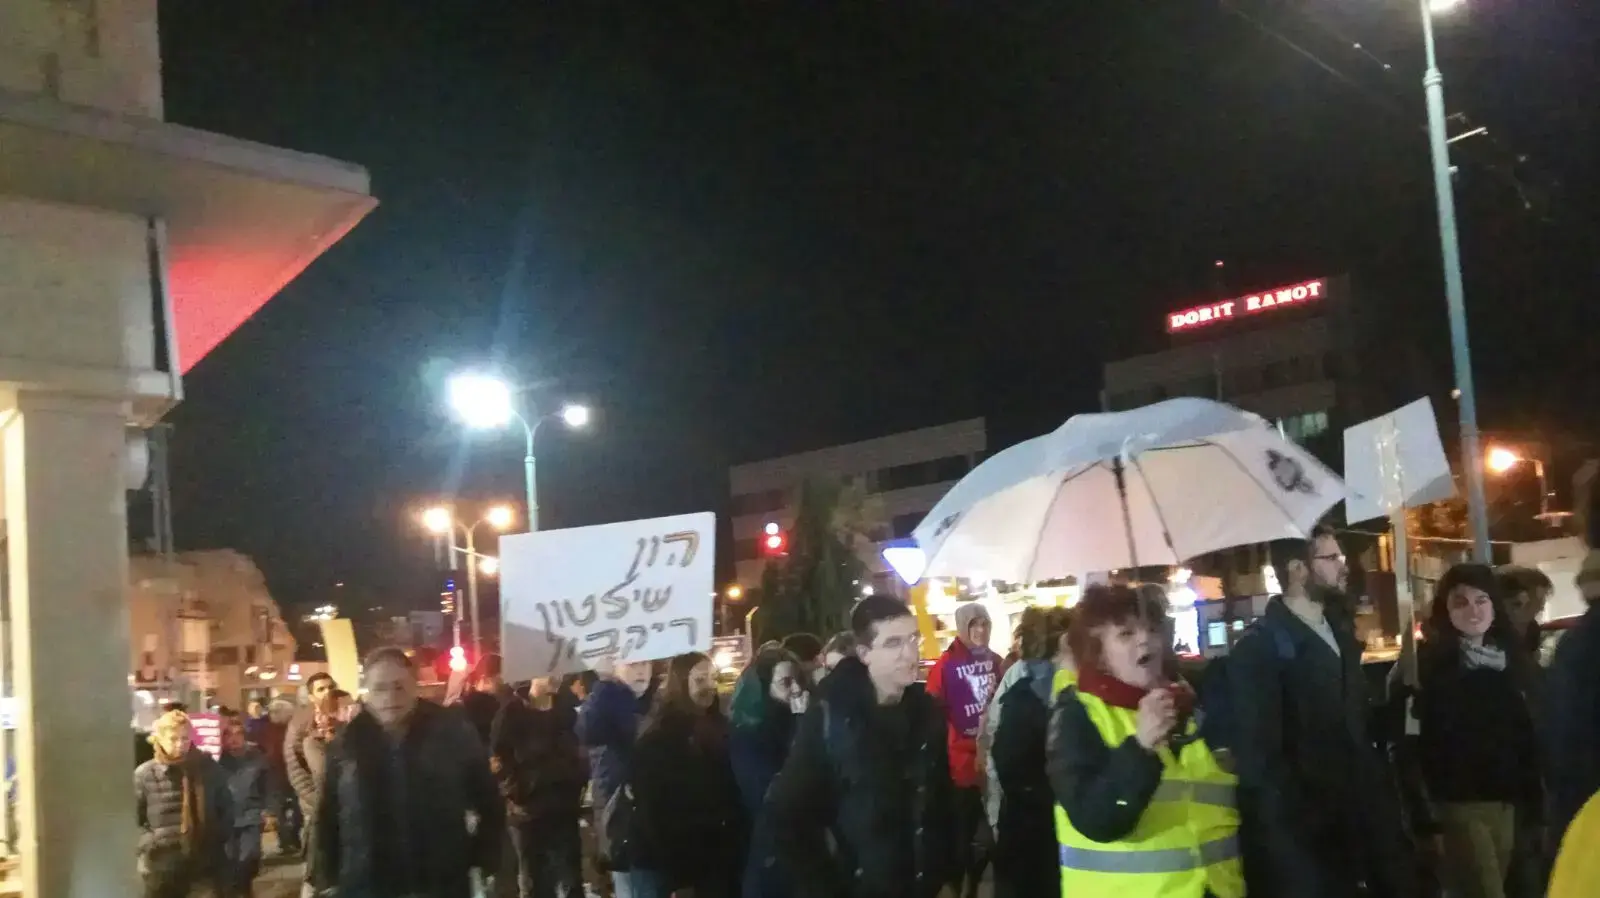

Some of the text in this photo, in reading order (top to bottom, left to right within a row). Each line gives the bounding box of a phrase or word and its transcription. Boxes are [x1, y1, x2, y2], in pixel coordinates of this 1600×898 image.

[1171, 281, 1322, 328] DORIT RAMOT
[625, 531, 700, 580] הון
[535, 574, 672, 642] שילטון
[548, 617, 698, 672] ריקבון
